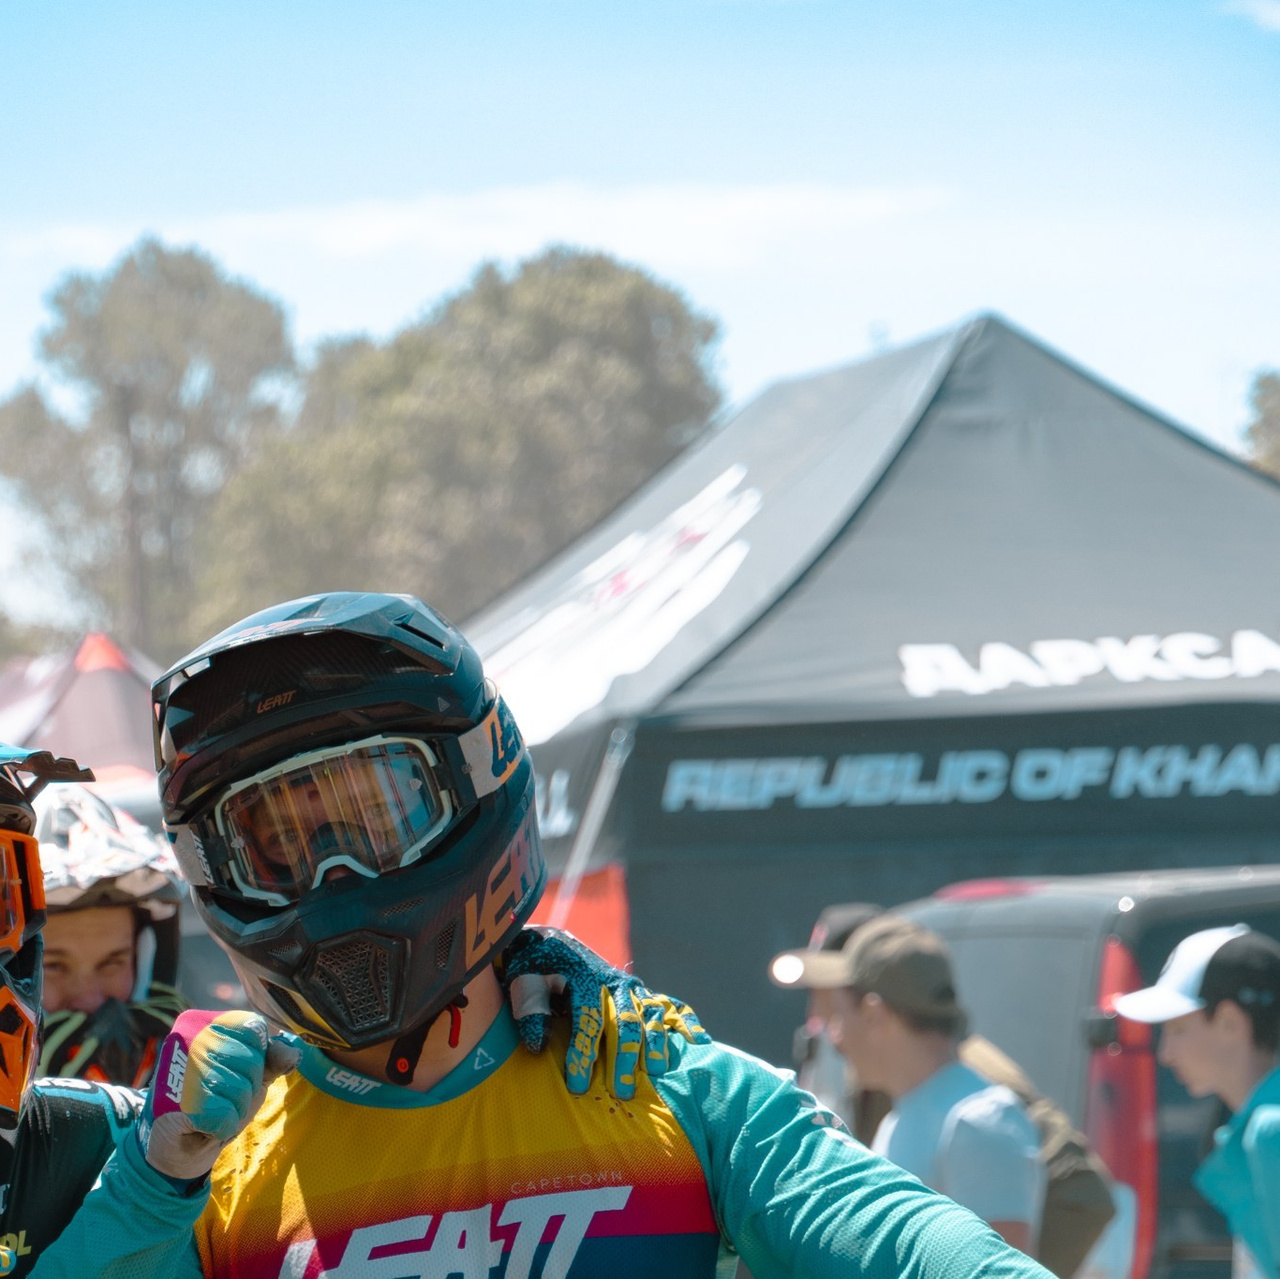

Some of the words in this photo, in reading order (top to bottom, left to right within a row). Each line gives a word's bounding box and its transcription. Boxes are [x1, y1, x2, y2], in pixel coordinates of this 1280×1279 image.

[256, 690, 297, 714] LEATT
[663, 752, 1010, 812] REPUBLIC
[1011, 747, 1114, 800] OF
[166, 1040, 188, 1104] LEATT
[325, 1066, 383, 1096] LEATT
[510, 1170, 624, 1195] CAPETOWN
